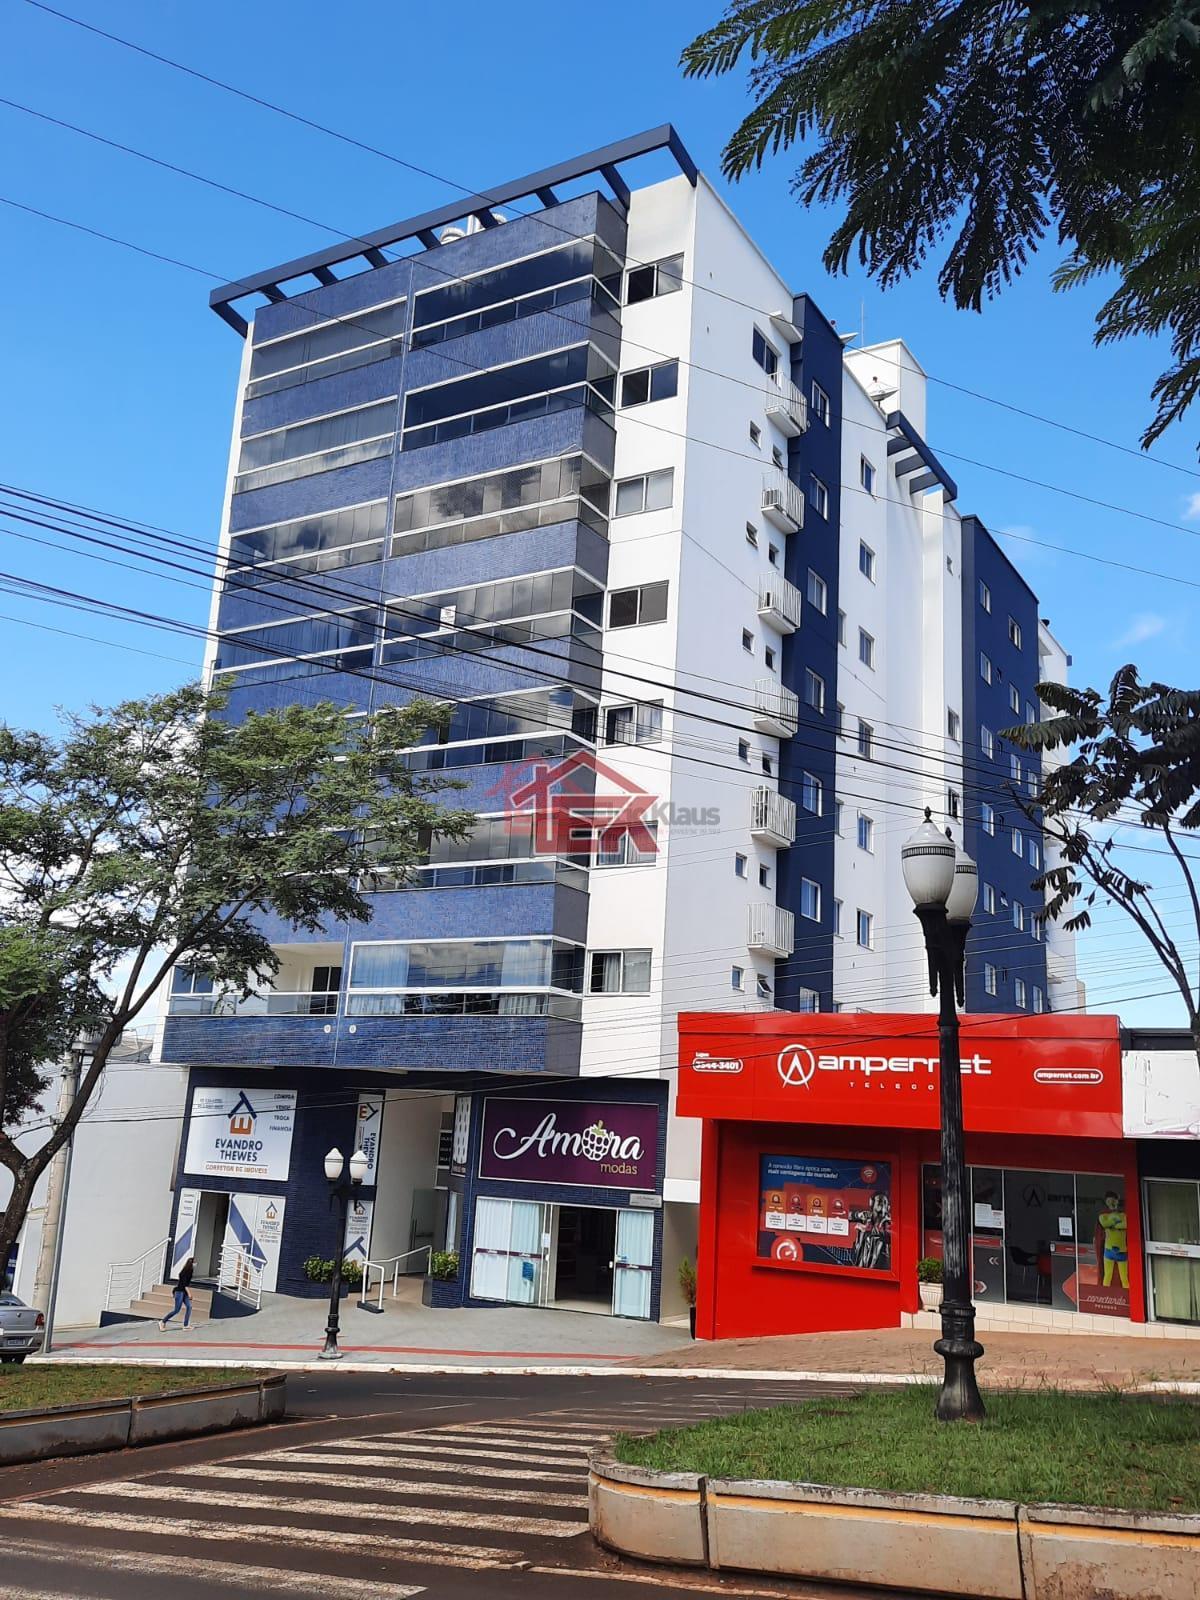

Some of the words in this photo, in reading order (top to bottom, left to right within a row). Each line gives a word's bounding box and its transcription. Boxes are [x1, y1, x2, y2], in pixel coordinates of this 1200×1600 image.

[493, 1112, 644, 1162] Amora
[215, 1139, 263, 1151] EVANDRO
[220, 1149, 258, 1162] THEWES
[600, 1162, 638, 1175] modas
